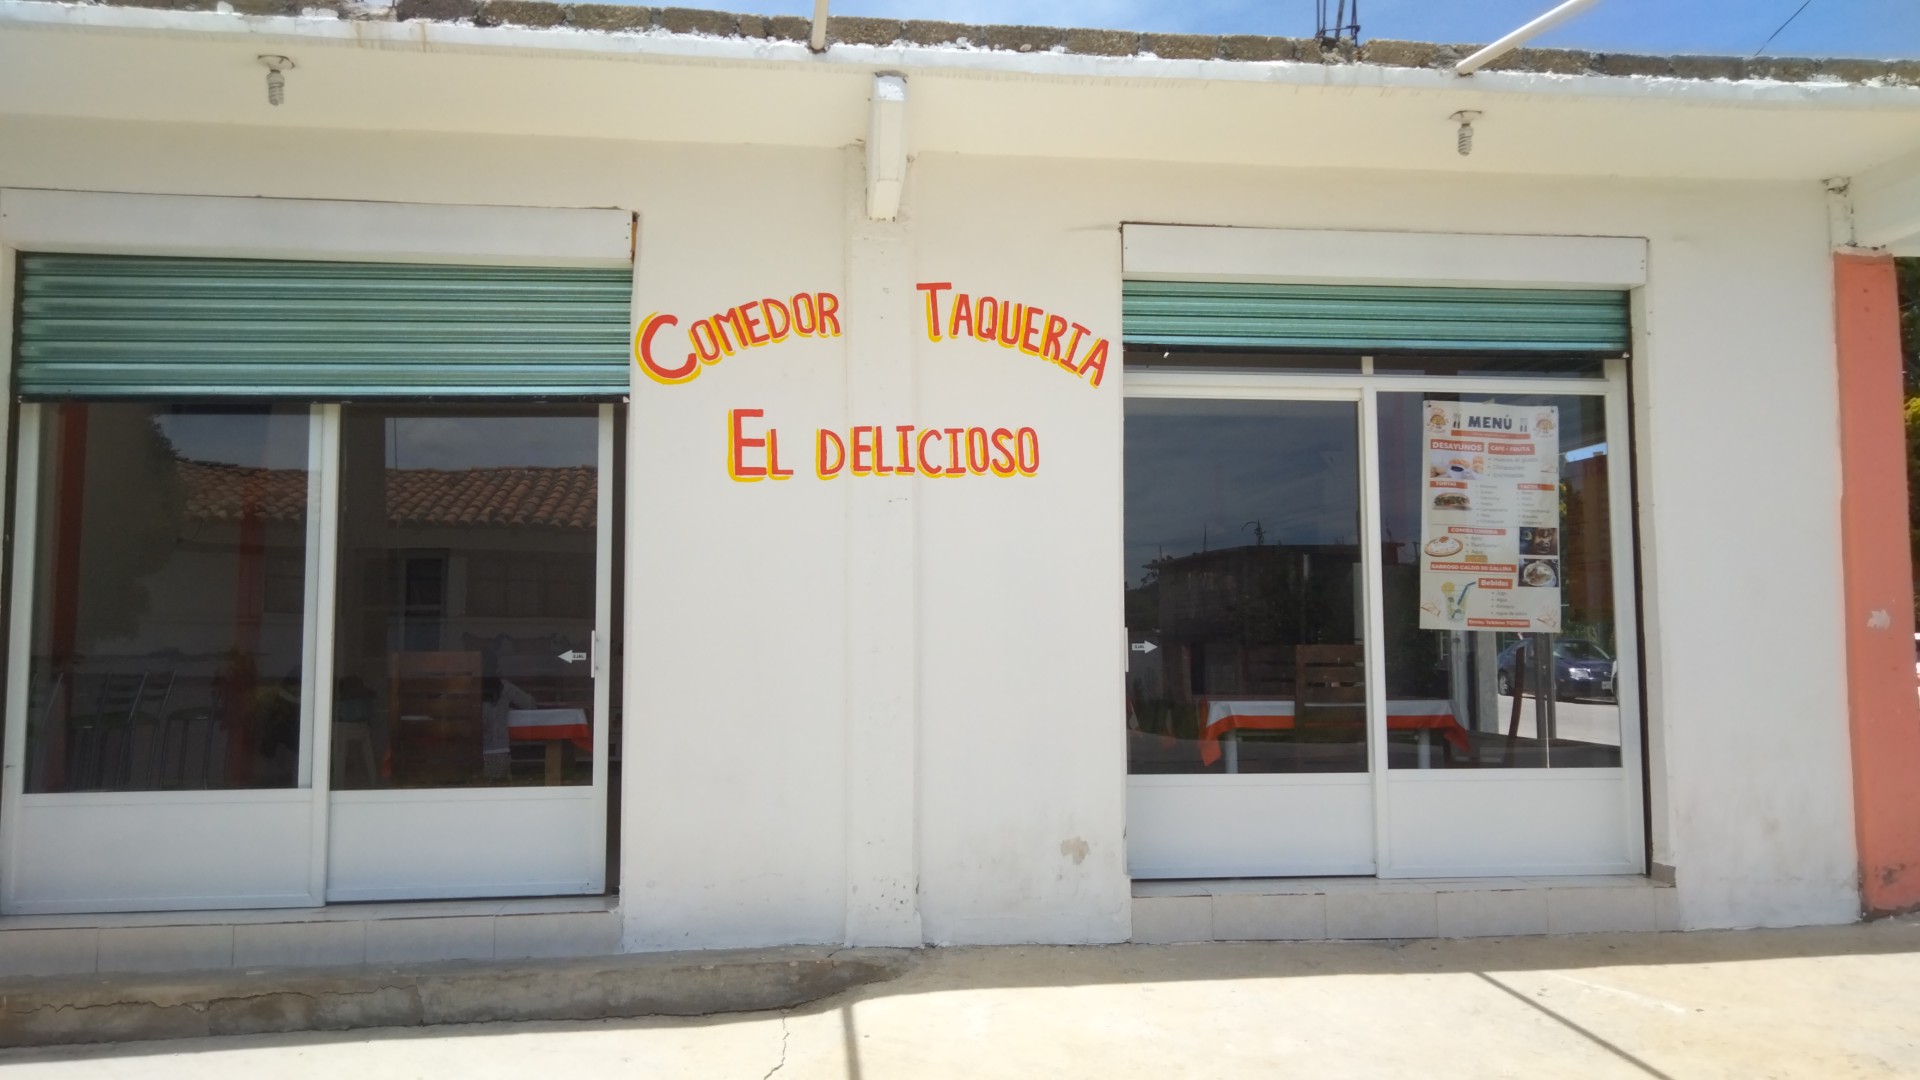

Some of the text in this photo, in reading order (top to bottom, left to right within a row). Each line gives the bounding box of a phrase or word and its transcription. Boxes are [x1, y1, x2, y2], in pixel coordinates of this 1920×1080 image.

[635, 292, 842, 385] COMEDOR
[917, 282, 1110, 388] TAQUERIA
[1468, 414, 1512, 430] MENÚ
[728, 409, 1040, 482] EL DELICIOSO
[1432, 441, 1482, 452] DESAYUNOS
[1481, 579, 1508, 587] Bebidas
